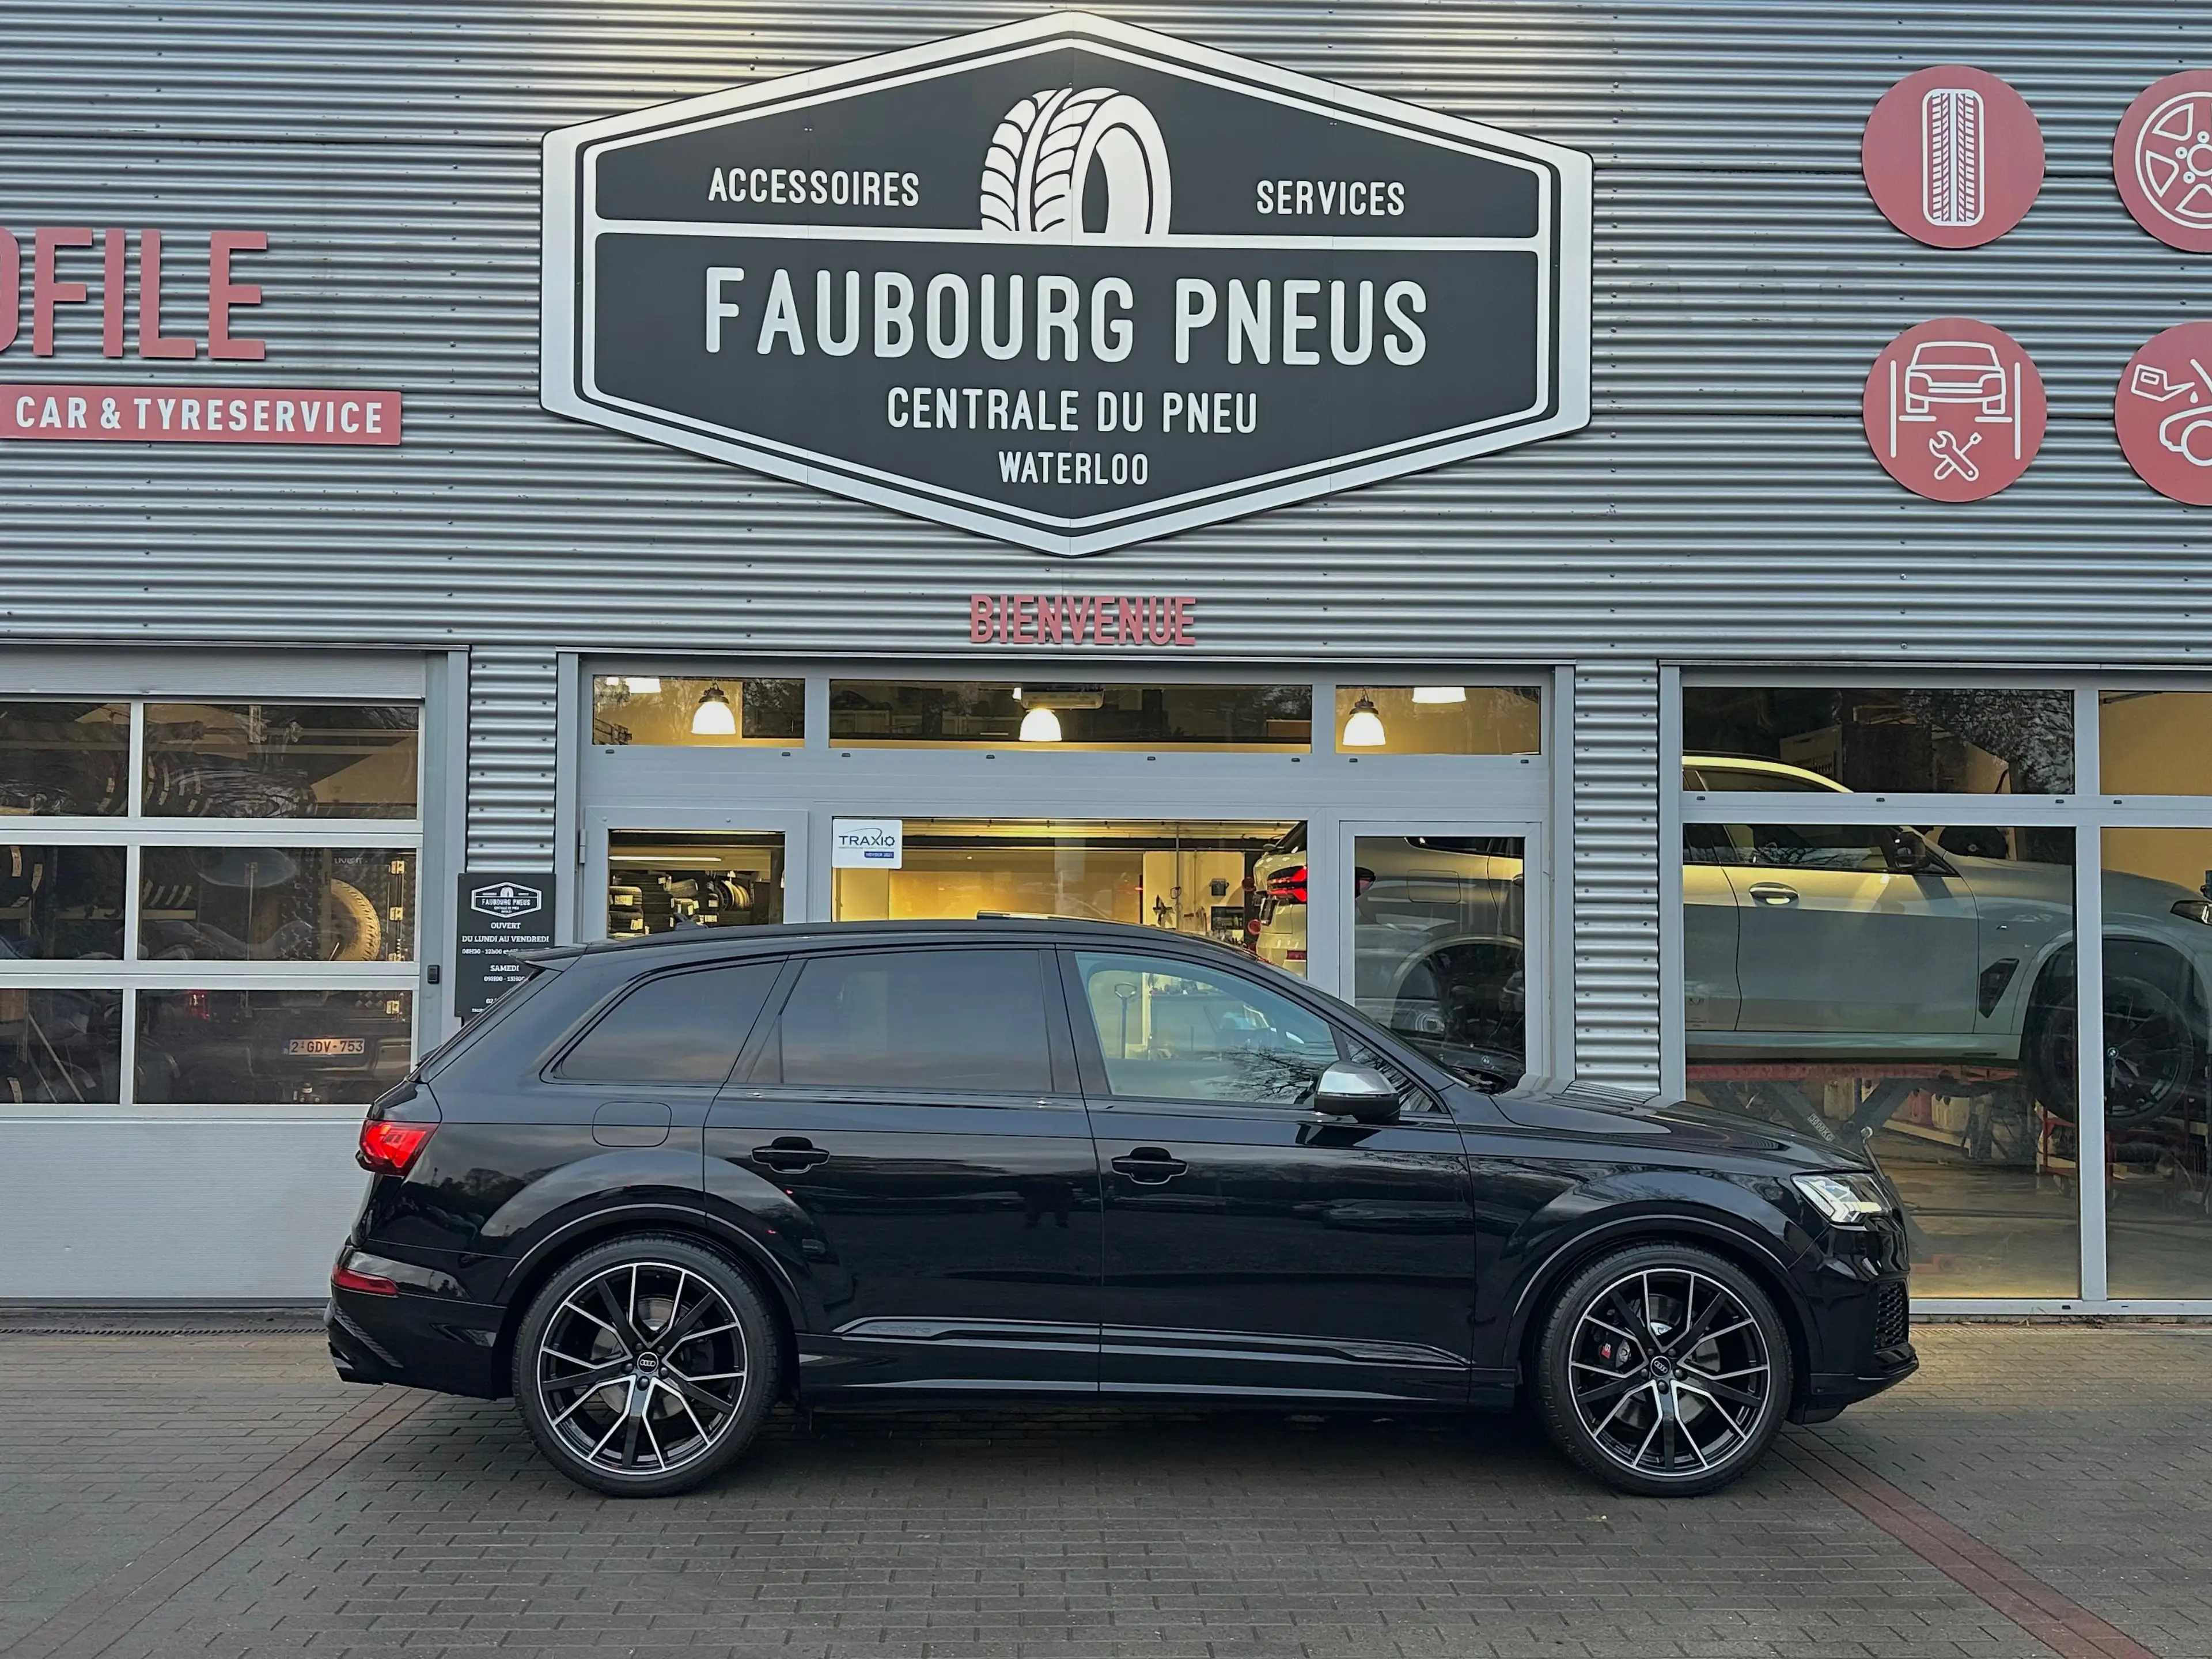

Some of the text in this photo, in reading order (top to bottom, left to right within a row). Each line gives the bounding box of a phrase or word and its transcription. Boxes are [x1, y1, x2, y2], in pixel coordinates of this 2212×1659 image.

[708, 167, 920, 207] ACCESSOIRES
[1256, 179, 1406, 216] SERVICES
[706, 266, 1427, 366] FAUBOURG PNEUS
[16, 395, 382, 434] CAR & TYRESERVICE
[887, 387, 1257, 433] CENTRALE DU PNEU
[998, 450, 1149, 485] WATERLOO
[970, 594, 1196, 646] BIENVENUE
[838, 835, 895, 846] TRAXIO
